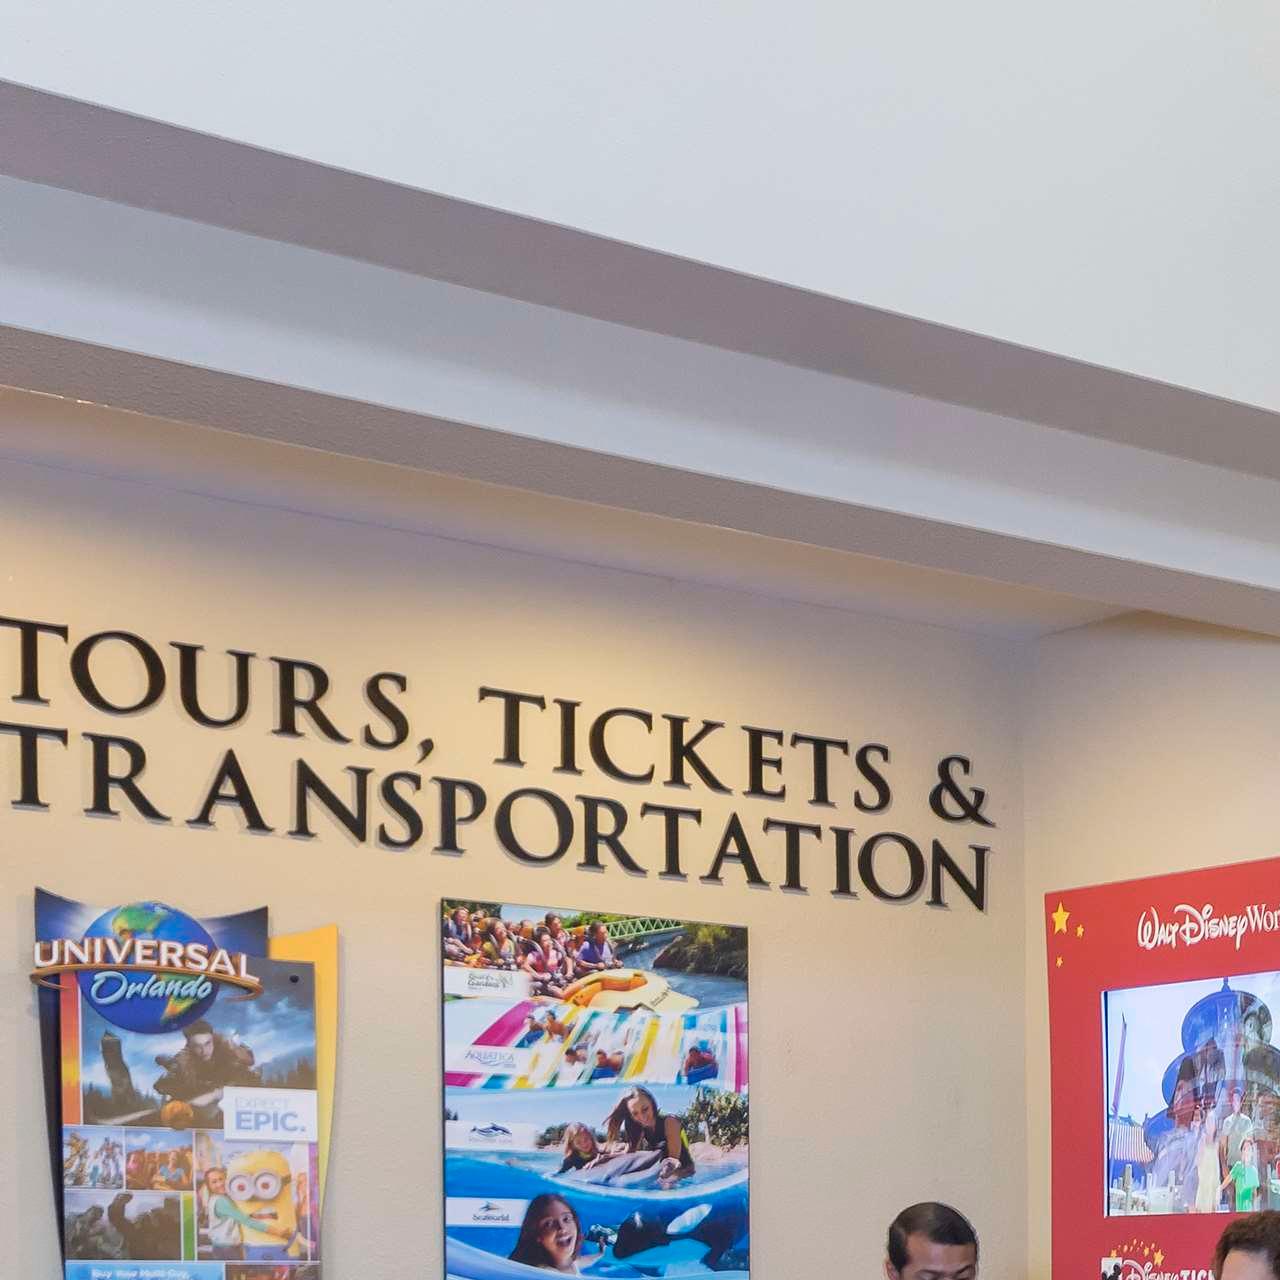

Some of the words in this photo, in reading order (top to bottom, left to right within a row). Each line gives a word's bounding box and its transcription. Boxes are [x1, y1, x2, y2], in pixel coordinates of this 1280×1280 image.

[0, 616, 435, 763] TOURS,
[479, 685, 891, 813] TICKETS
[928, 755, 997, 829] &
[0, 721, 990, 913] TRANSPORTATION
[34, 938, 261, 984] UNIVERSAL
[90, 970, 213, 1006] Orlando
[235, 1111, 307, 1132] EPIC.
